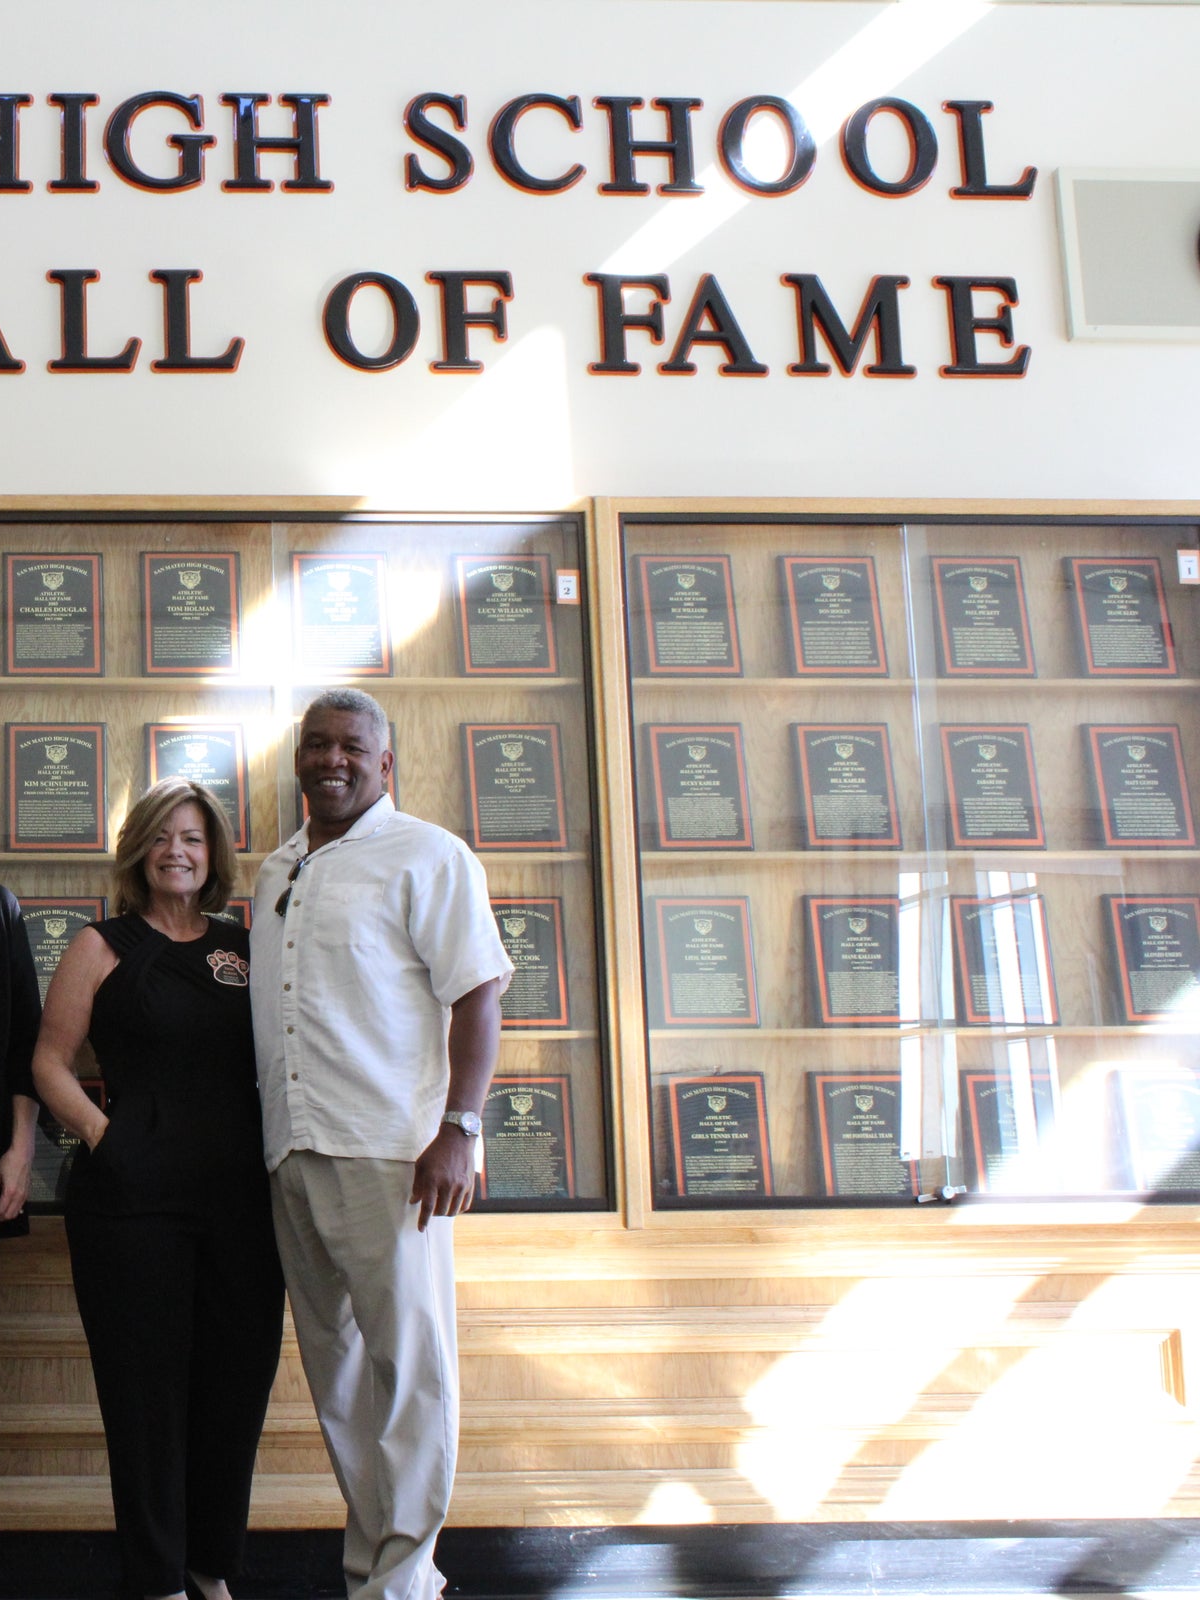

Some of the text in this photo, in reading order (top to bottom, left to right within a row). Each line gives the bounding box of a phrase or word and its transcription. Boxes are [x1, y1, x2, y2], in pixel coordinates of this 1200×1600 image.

[403, 94, 1037, 200] SCHOOL
[321, 272, 512, 374] OF
[583, 274, 1030, 379] FAME
